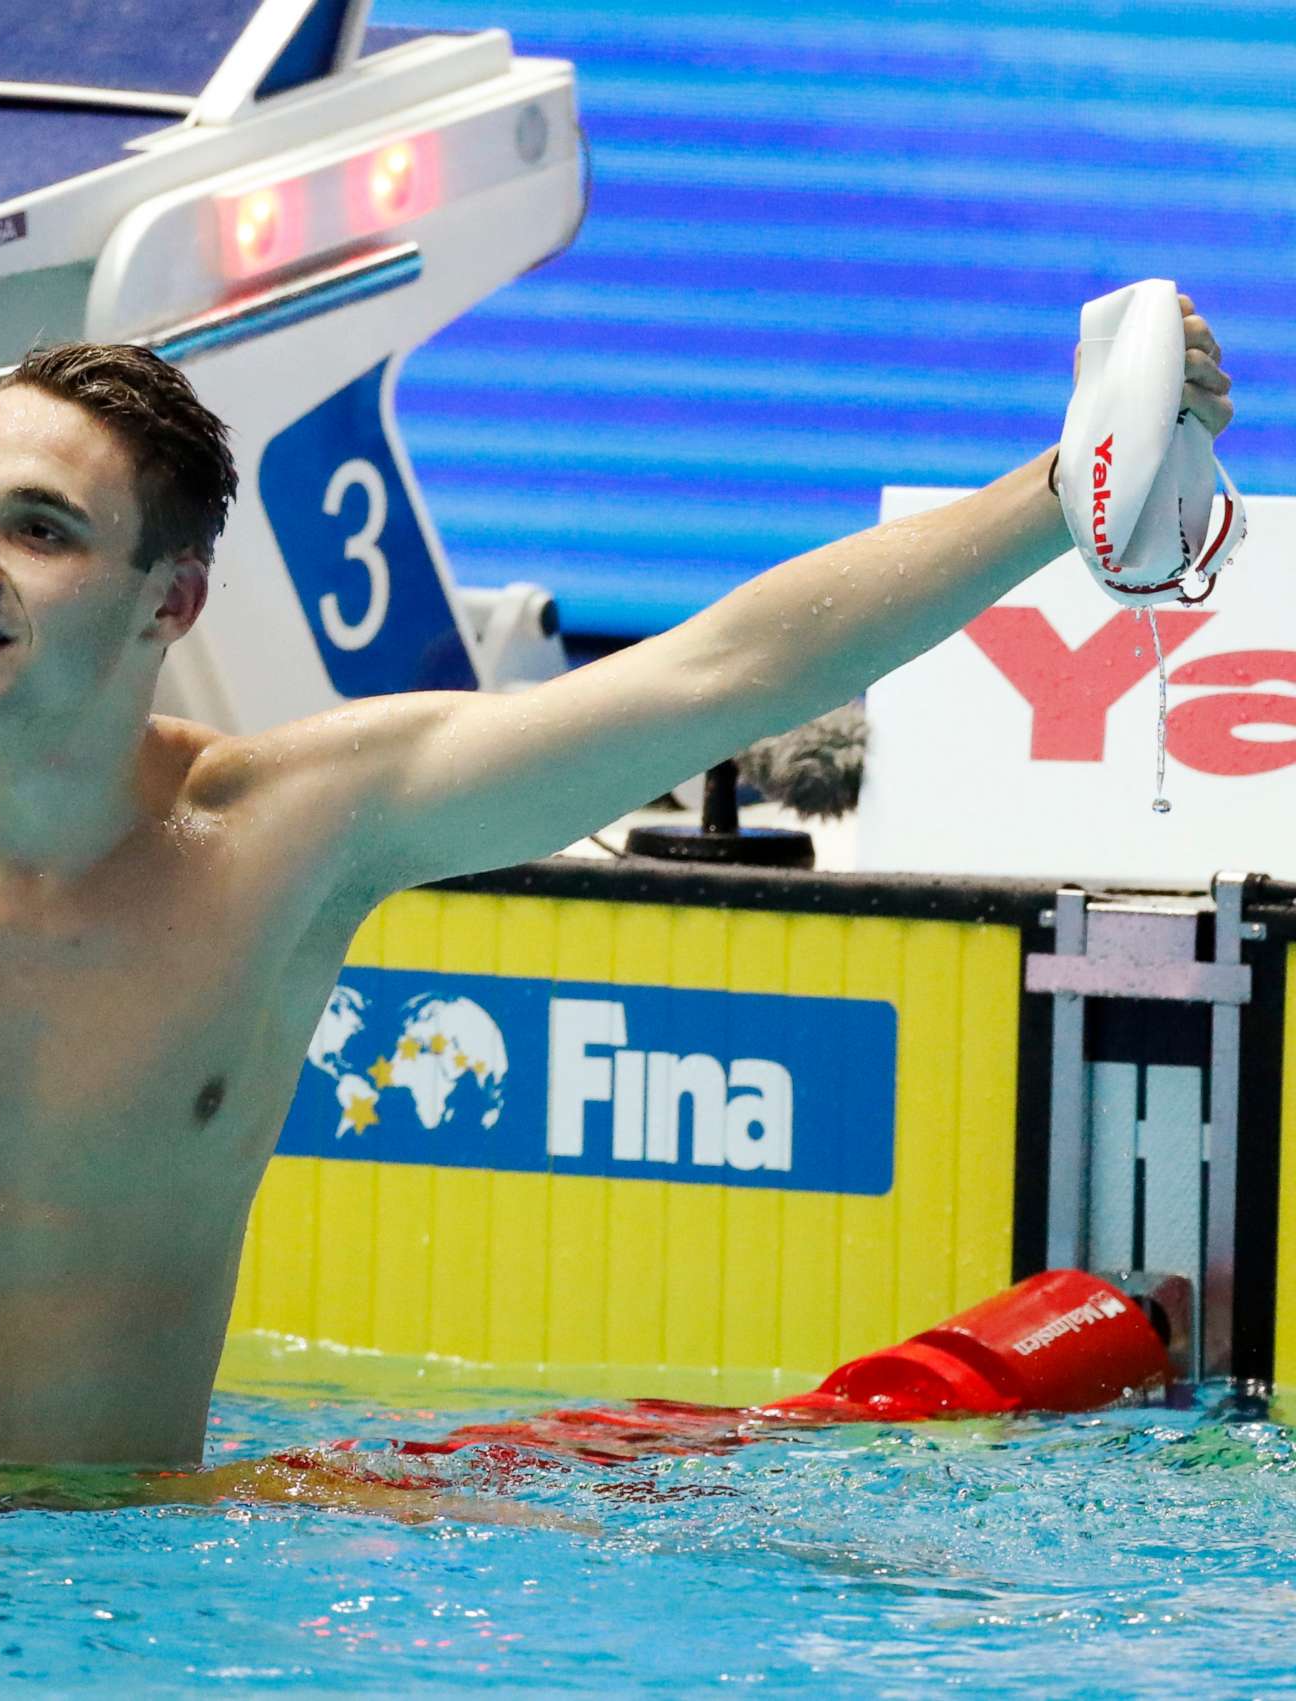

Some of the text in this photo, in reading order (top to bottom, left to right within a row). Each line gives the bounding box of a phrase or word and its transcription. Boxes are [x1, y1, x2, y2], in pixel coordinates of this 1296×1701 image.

[319, 458, 391, 651] 3
[962, 606, 1296, 776] Ya
[546, 997, 794, 1172] Fina
[1011, 1302, 1105, 1356] Malmsten
